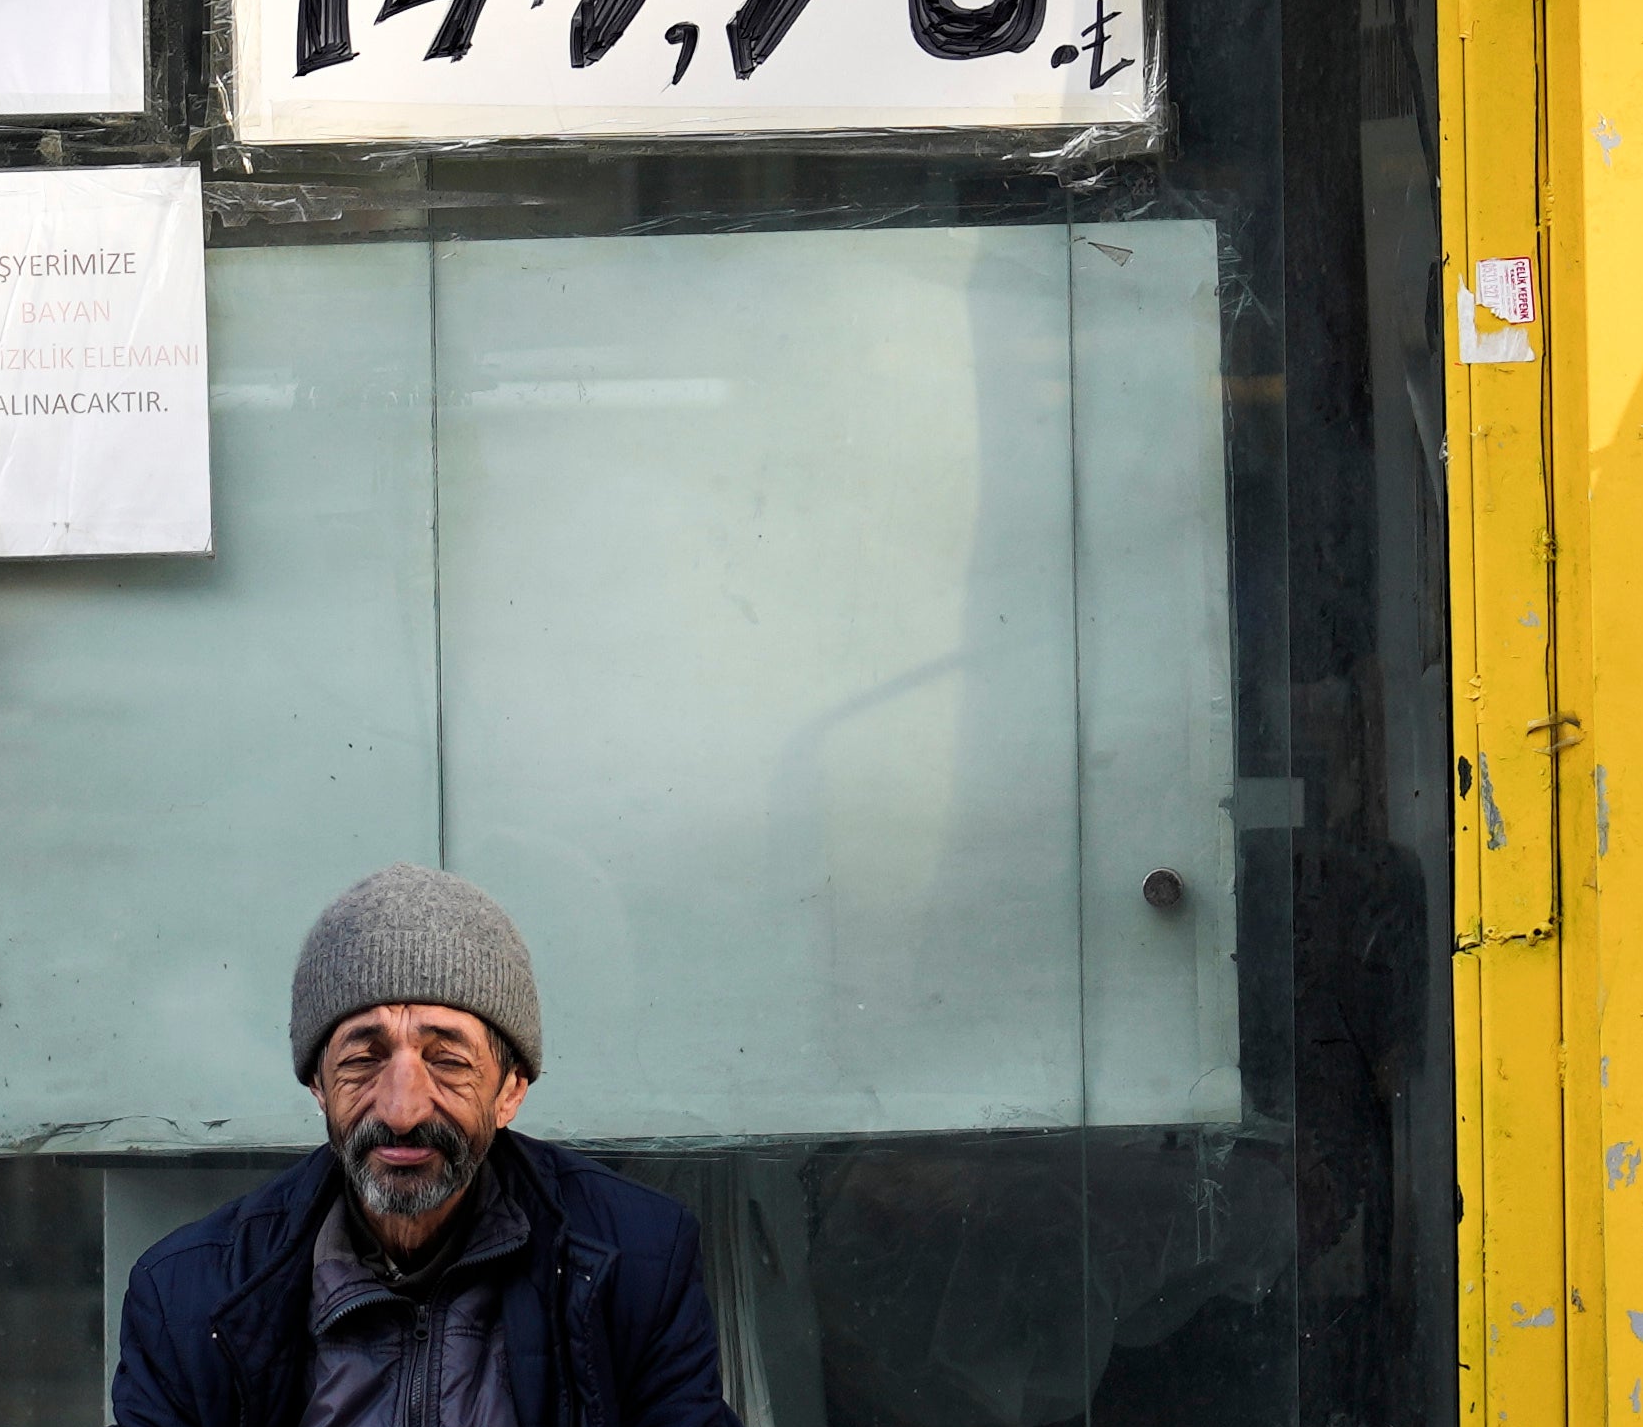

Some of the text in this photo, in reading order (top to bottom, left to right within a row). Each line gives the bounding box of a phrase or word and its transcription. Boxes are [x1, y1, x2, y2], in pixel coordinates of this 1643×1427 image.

[1516, 261, 1530, 320] ÇELİK KEPENK
[22, 300, 111, 324] BAYAN
[83, 343, 200, 370] ELEMANI
